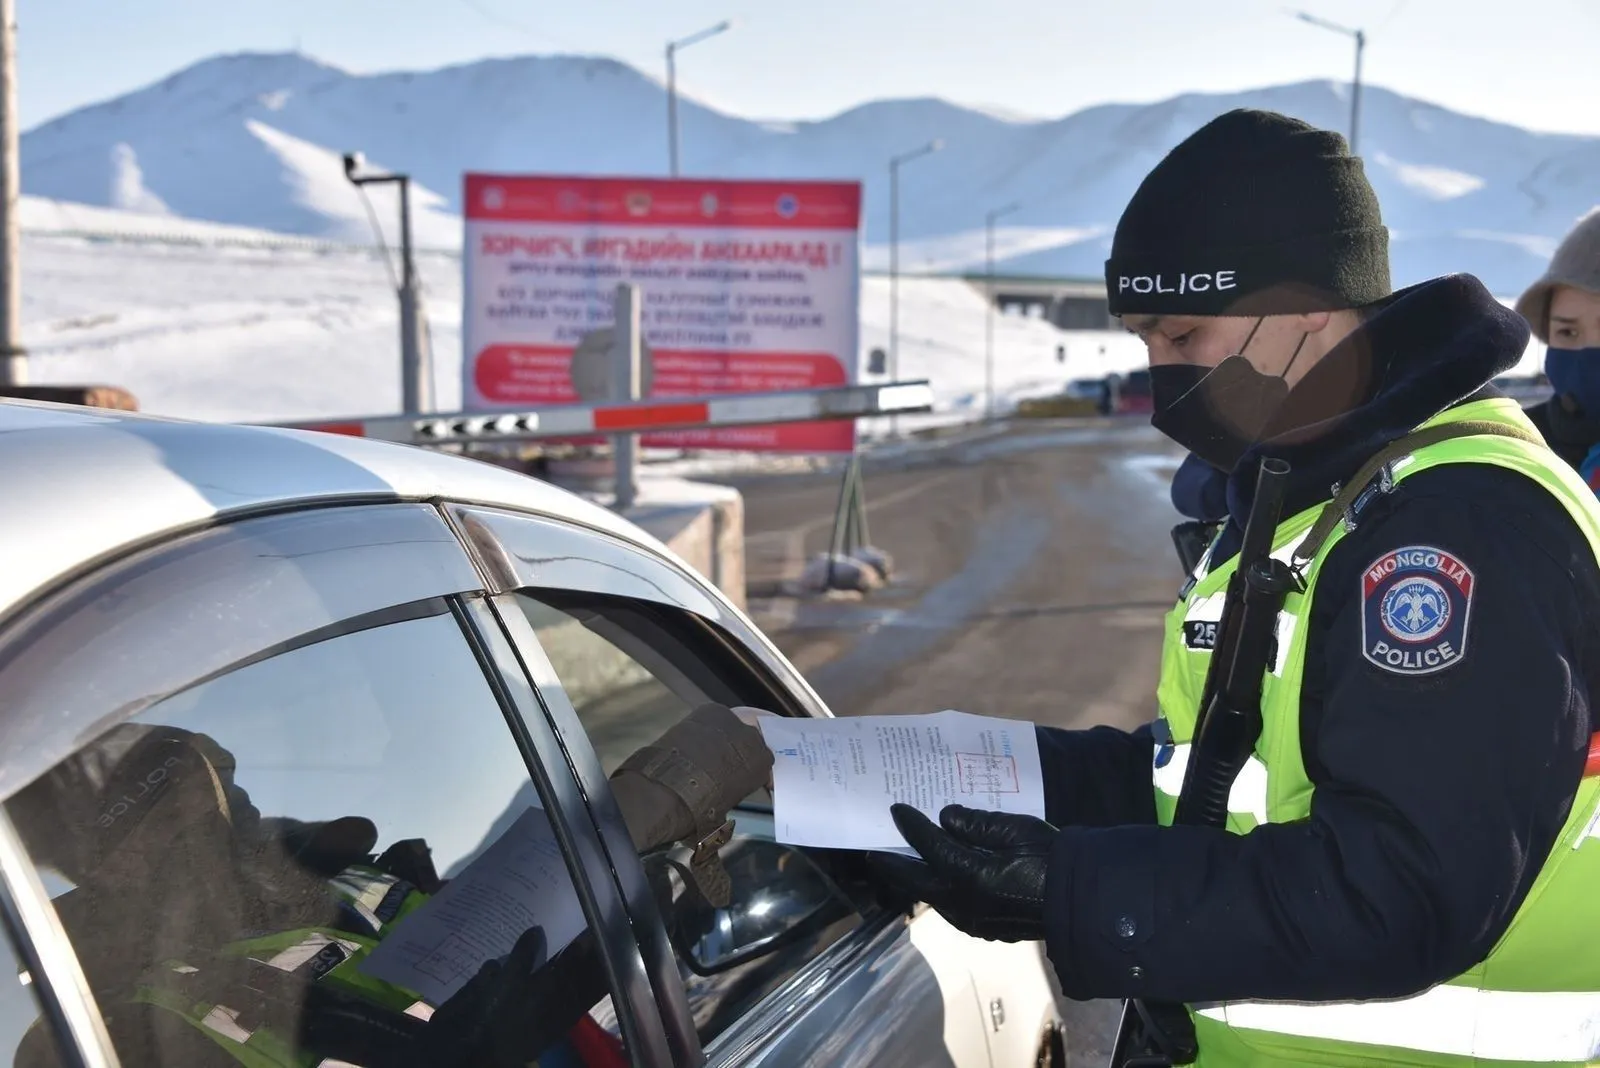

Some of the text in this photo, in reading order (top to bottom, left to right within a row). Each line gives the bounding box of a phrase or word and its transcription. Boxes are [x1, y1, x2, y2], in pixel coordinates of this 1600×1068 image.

[1119, 271, 1236, 295] POLICE
[1369, 551, 1466, 584] MONGOLIA
[1371, 640, 1455, 668] POLICE
